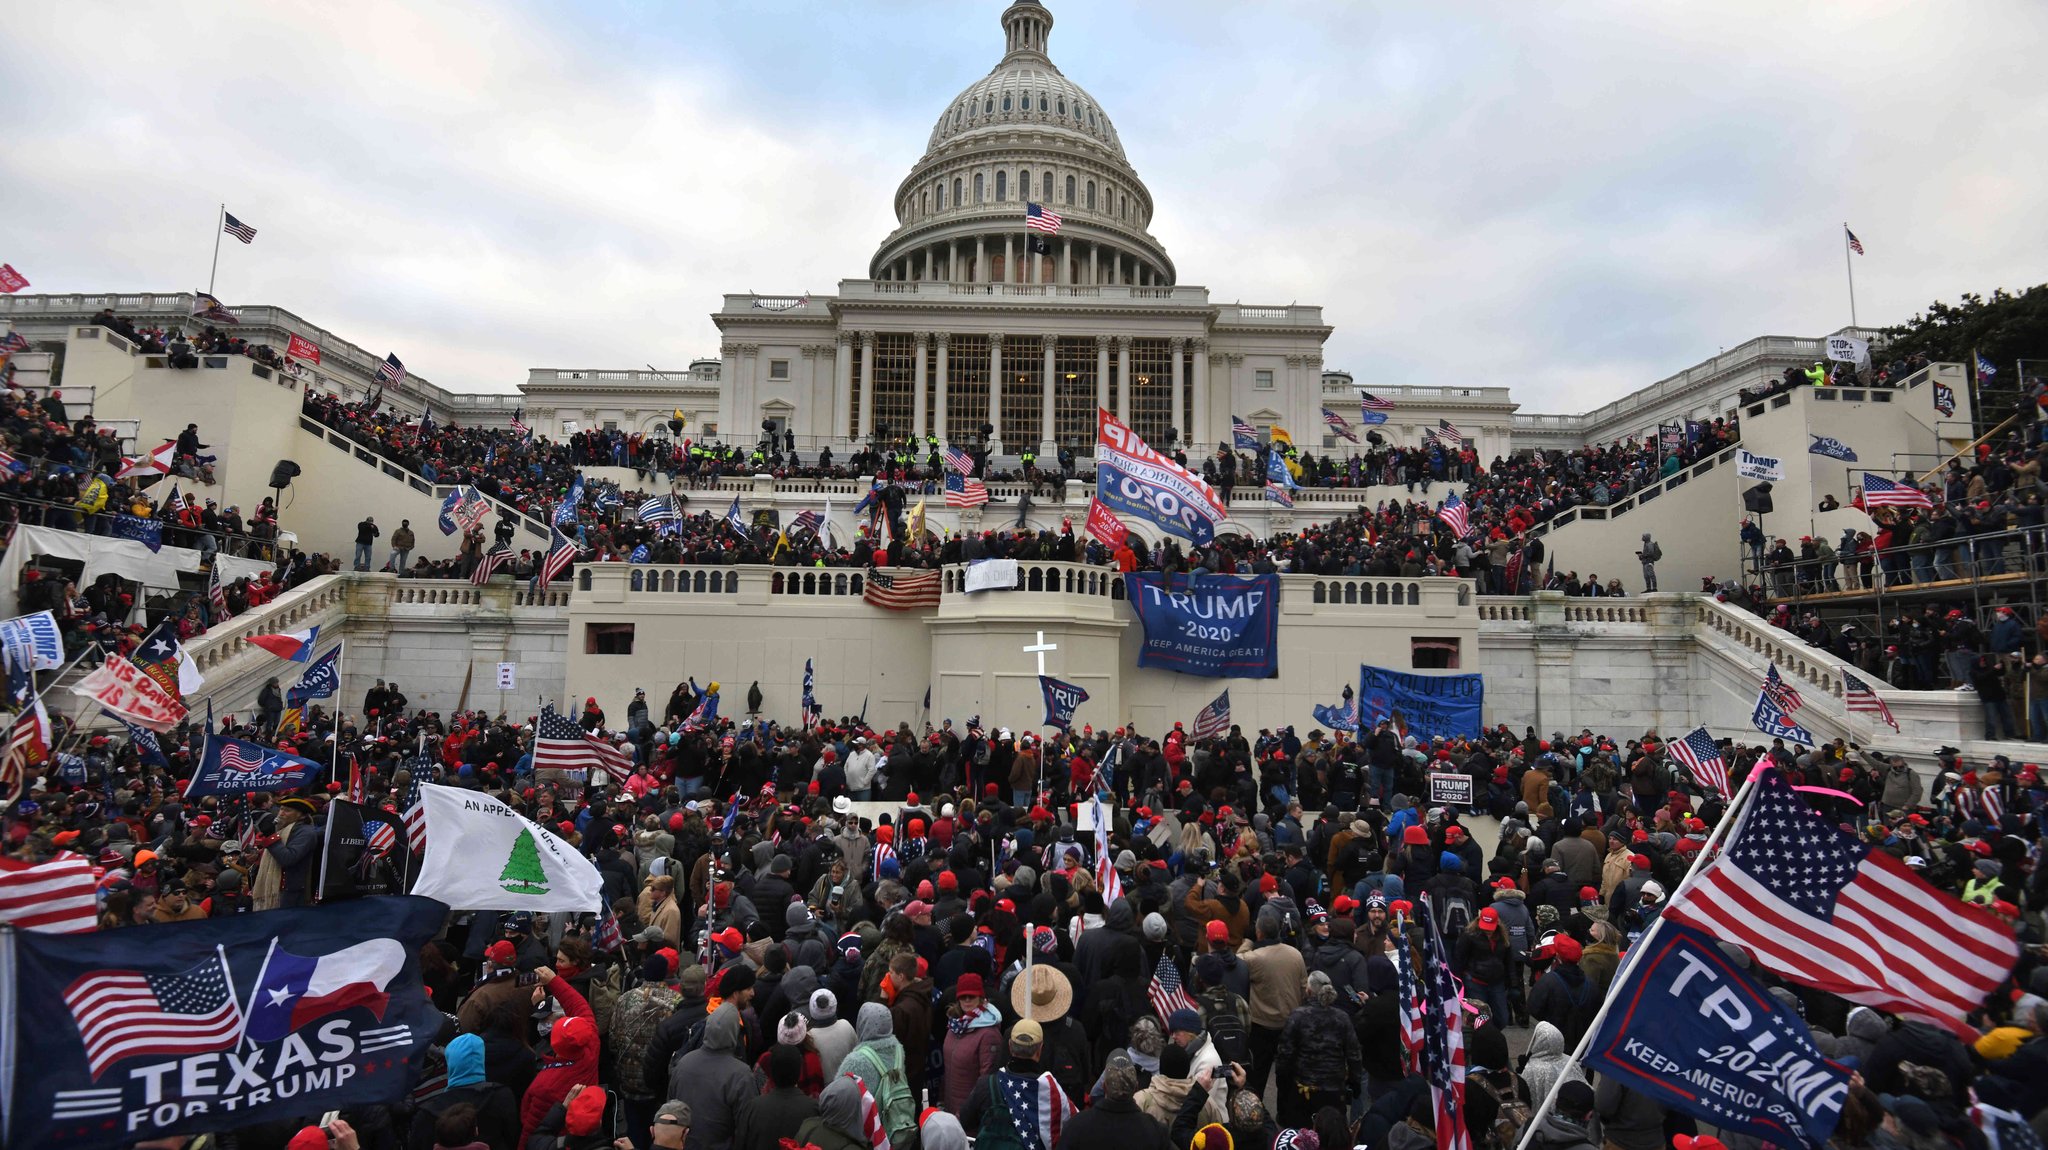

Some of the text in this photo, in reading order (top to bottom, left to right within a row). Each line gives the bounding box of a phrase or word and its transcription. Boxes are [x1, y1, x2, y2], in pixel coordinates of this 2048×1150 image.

[1144, 585, 1263, 619] TRUMP
[26, 614, 57, 660] TRUMP
[1175, 643, 1226, 658] AMERICA
[105, 656, 135, 683] HIS
[97, 684, 123, 706] IS
[1418, 713, 1452, 725] NEWS
[1756, 716, 1809, 743] STEAL
[130, 731, 161, 752] TRUMP
[217, 779, 282, 789] FOR TRUMP
[1434, 780, 1469, 791] TRUMP
[464, 800, 480, 811] AN
[129, 1019, 355, 1106] TEXAS
[1624, 1037, 1679, 1074] KEEP
[127, 1064, 356, 1132] FOR TRUMP
